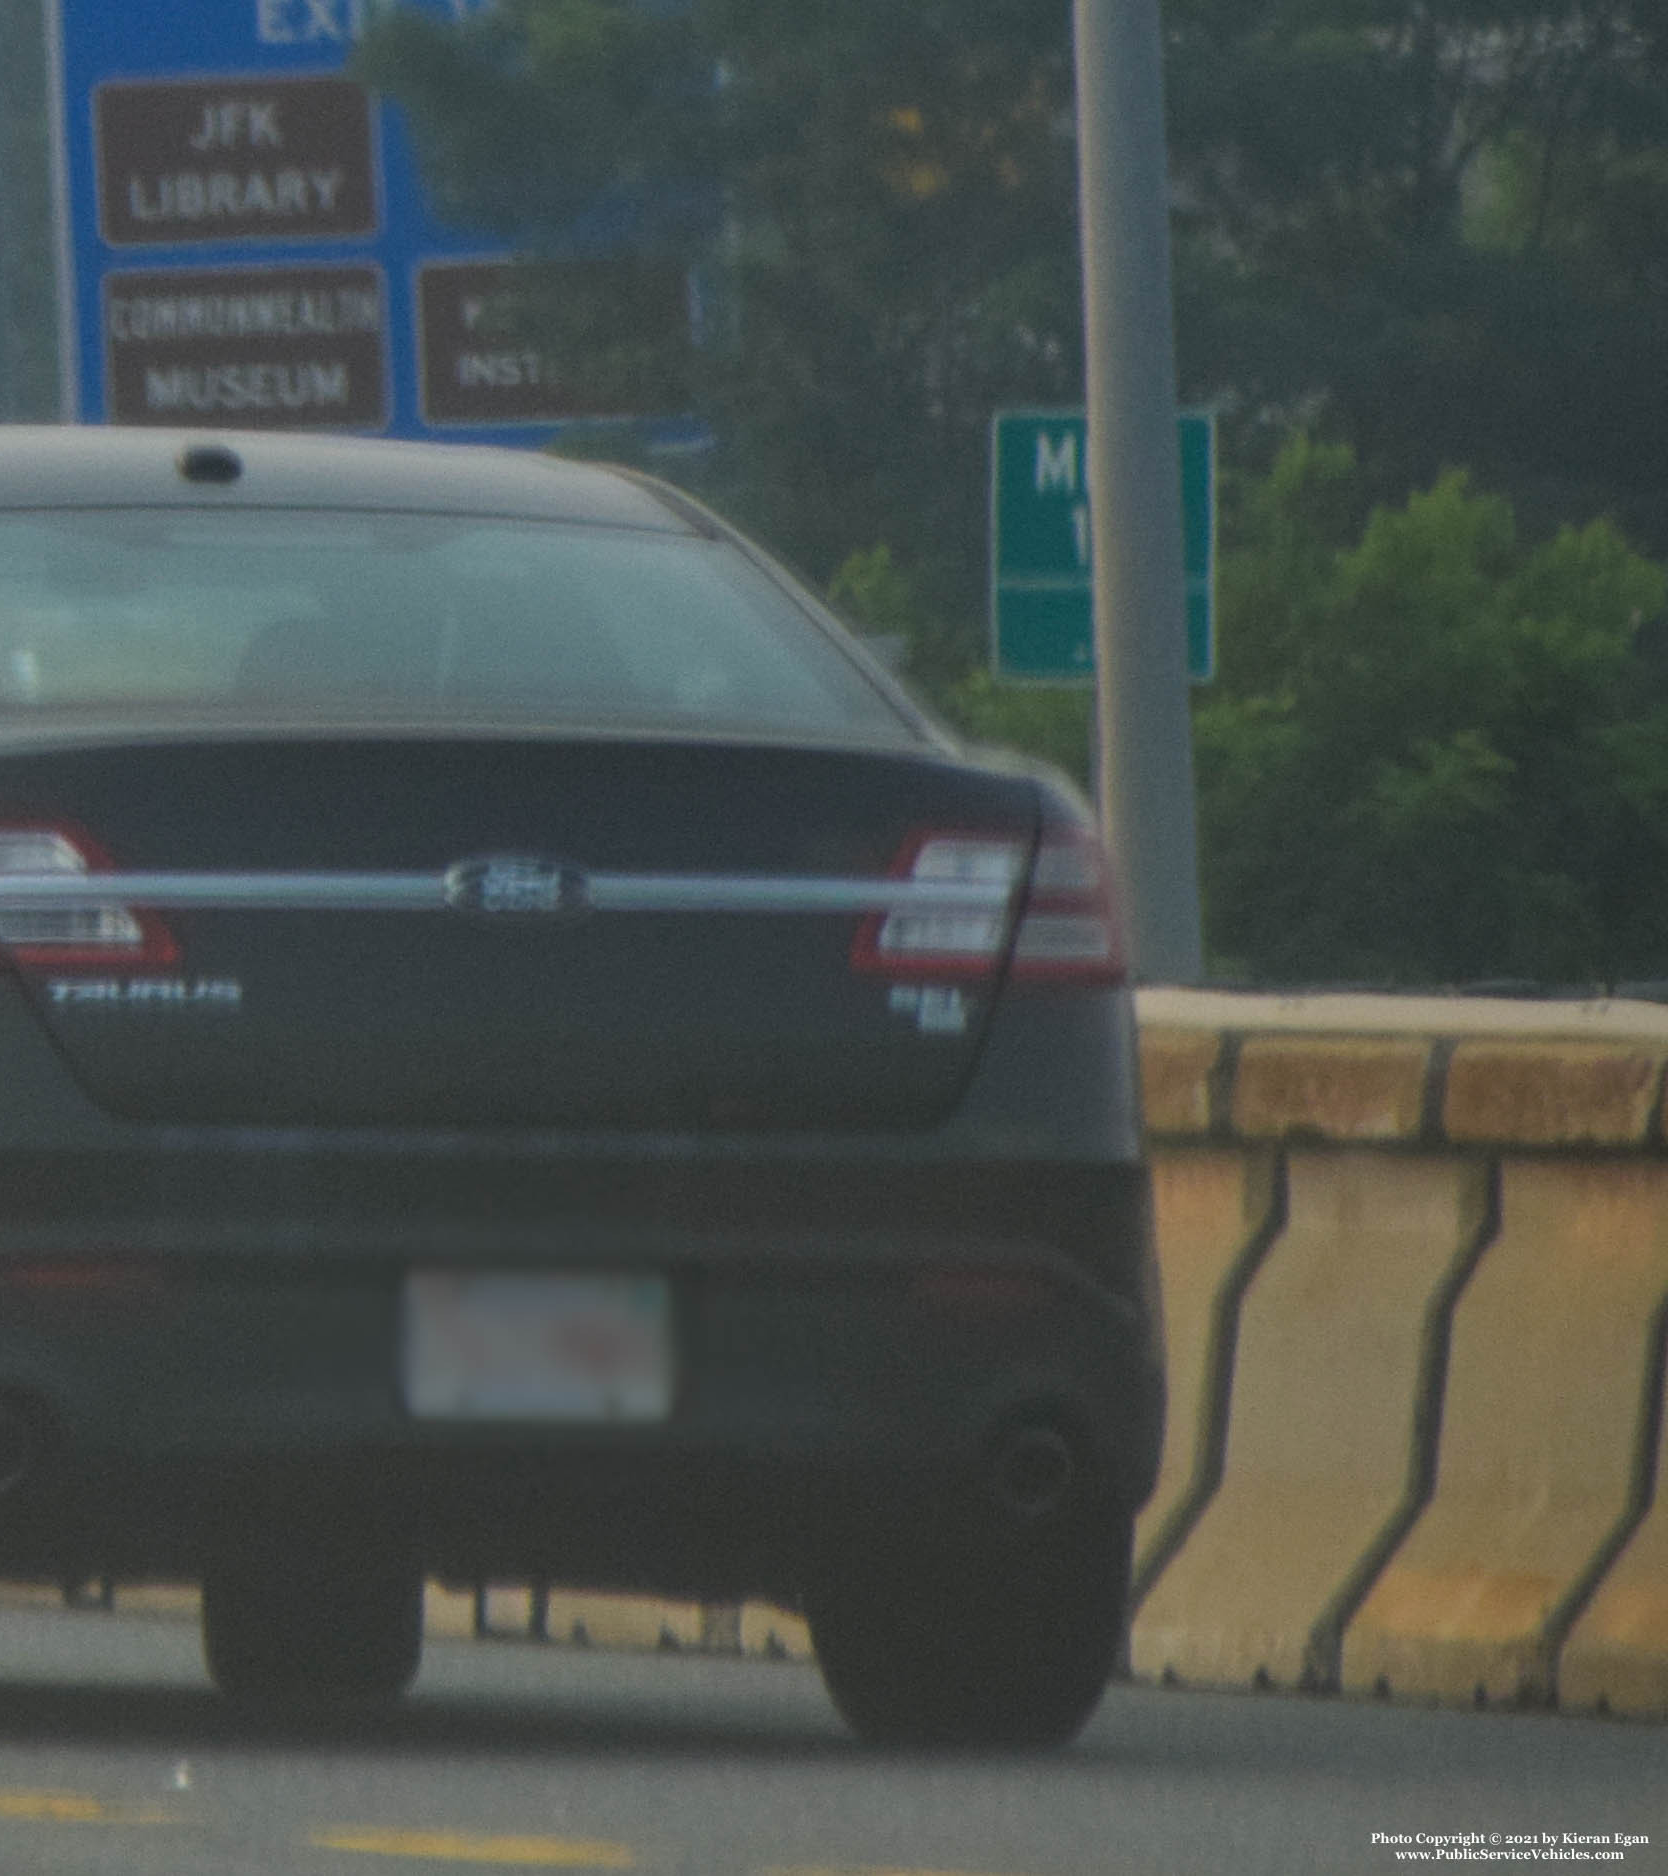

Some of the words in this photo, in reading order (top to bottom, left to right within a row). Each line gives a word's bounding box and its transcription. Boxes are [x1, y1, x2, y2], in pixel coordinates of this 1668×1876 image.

[189, 101, 281, 149] JFK
[130, 167, 343, 219] LIBRARY
[146, 363, 347, 411] MUSEUM
